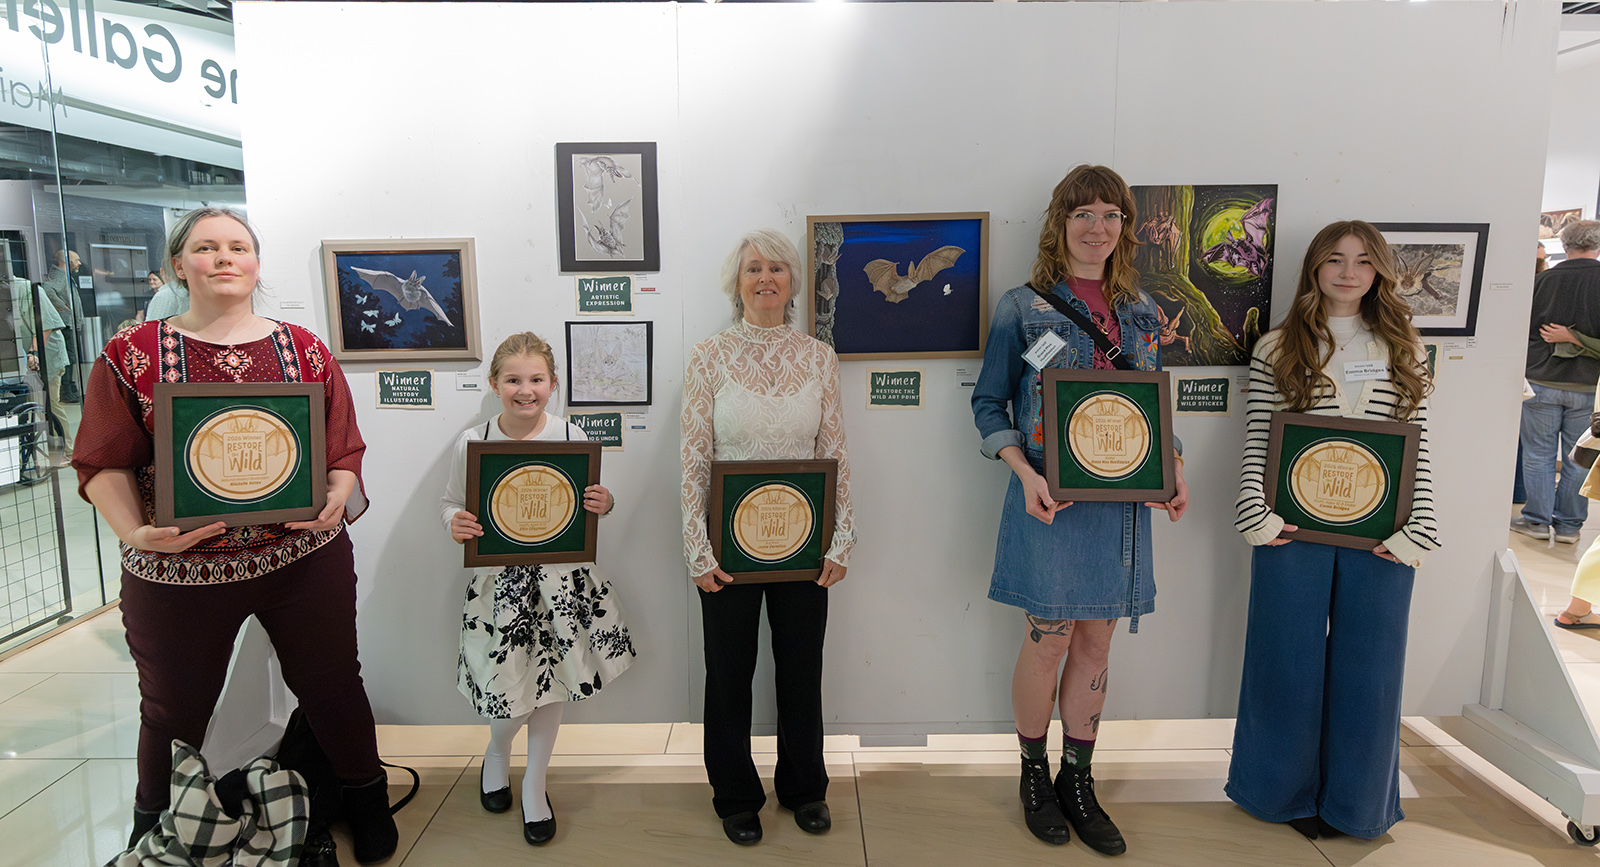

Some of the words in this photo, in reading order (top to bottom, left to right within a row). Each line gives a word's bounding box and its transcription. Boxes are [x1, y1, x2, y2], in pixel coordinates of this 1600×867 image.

[582, 280, 626, 292] Winner
[382, 373, 427, 386] Winner
[874, 374, 916, 386] Winner
[1182, 381, 1225, 393] Winner
[574, 416, 617, 428] Winner
[1096, 425, 1122, 434] RESTORE
[227, 441, 262, 454] RESTORE
[1097, 431, 1123, 452] Wild
[228, 450, 262, 473] Wild
[1323, 469, 1354, 482] RESTORE
[1323, 477, 1352, 498] Wild
[520, 494, 548, 503] RESTORE
[520, 500, 547, 520] Wild
[760, 512, 786, 522] RESTORE
[760, 518, 785, 538] Wild
